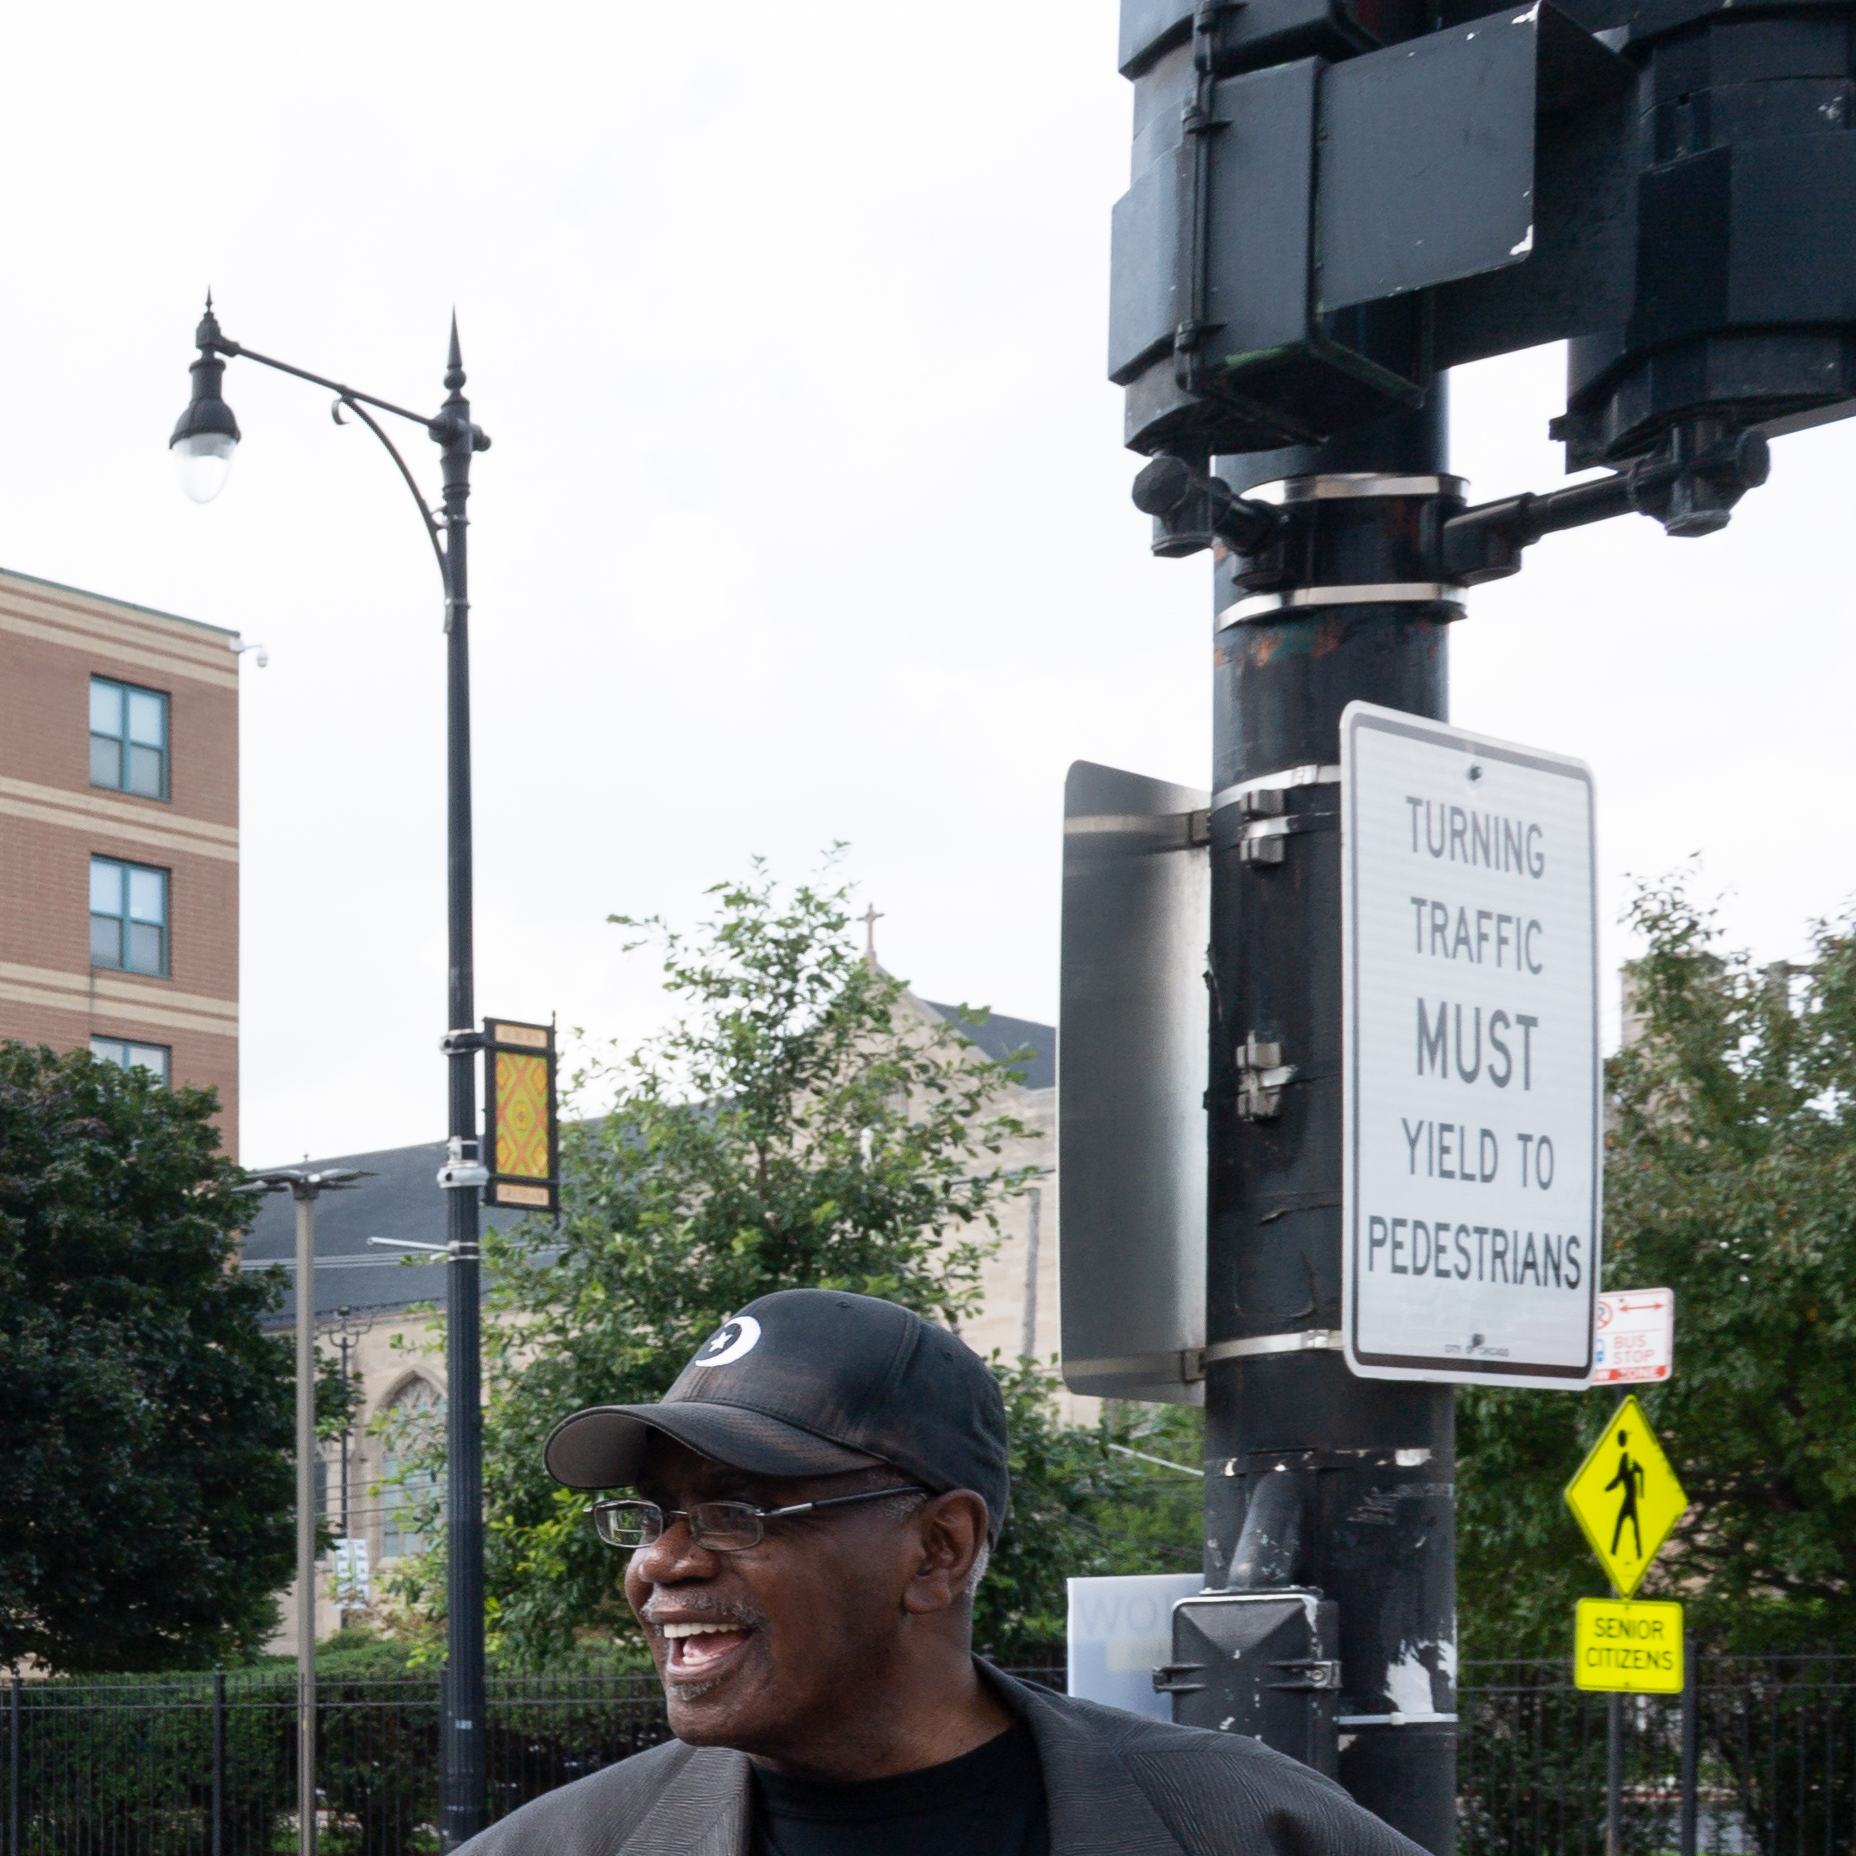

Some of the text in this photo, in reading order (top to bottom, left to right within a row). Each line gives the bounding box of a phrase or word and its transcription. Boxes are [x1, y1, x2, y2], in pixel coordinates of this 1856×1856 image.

[1406, 796, 1544, 879] TURNING
[1410, 896, 1543, 975] TRAFFIC
[1417, 997, 1538, 1091] MUST
[1401, 1117, 1555, 1191] YIELD TO
[1368, 1214, 1581, 1290] PEDESTRIANS
[1614, 1334, 1647, 1349] BUS
[1614, 1349, 1655, 1365] STOP
[1587, 1647, 1673, 1671] CITIZENS
[1594, 1617, 1664, 1640] SENIOR
